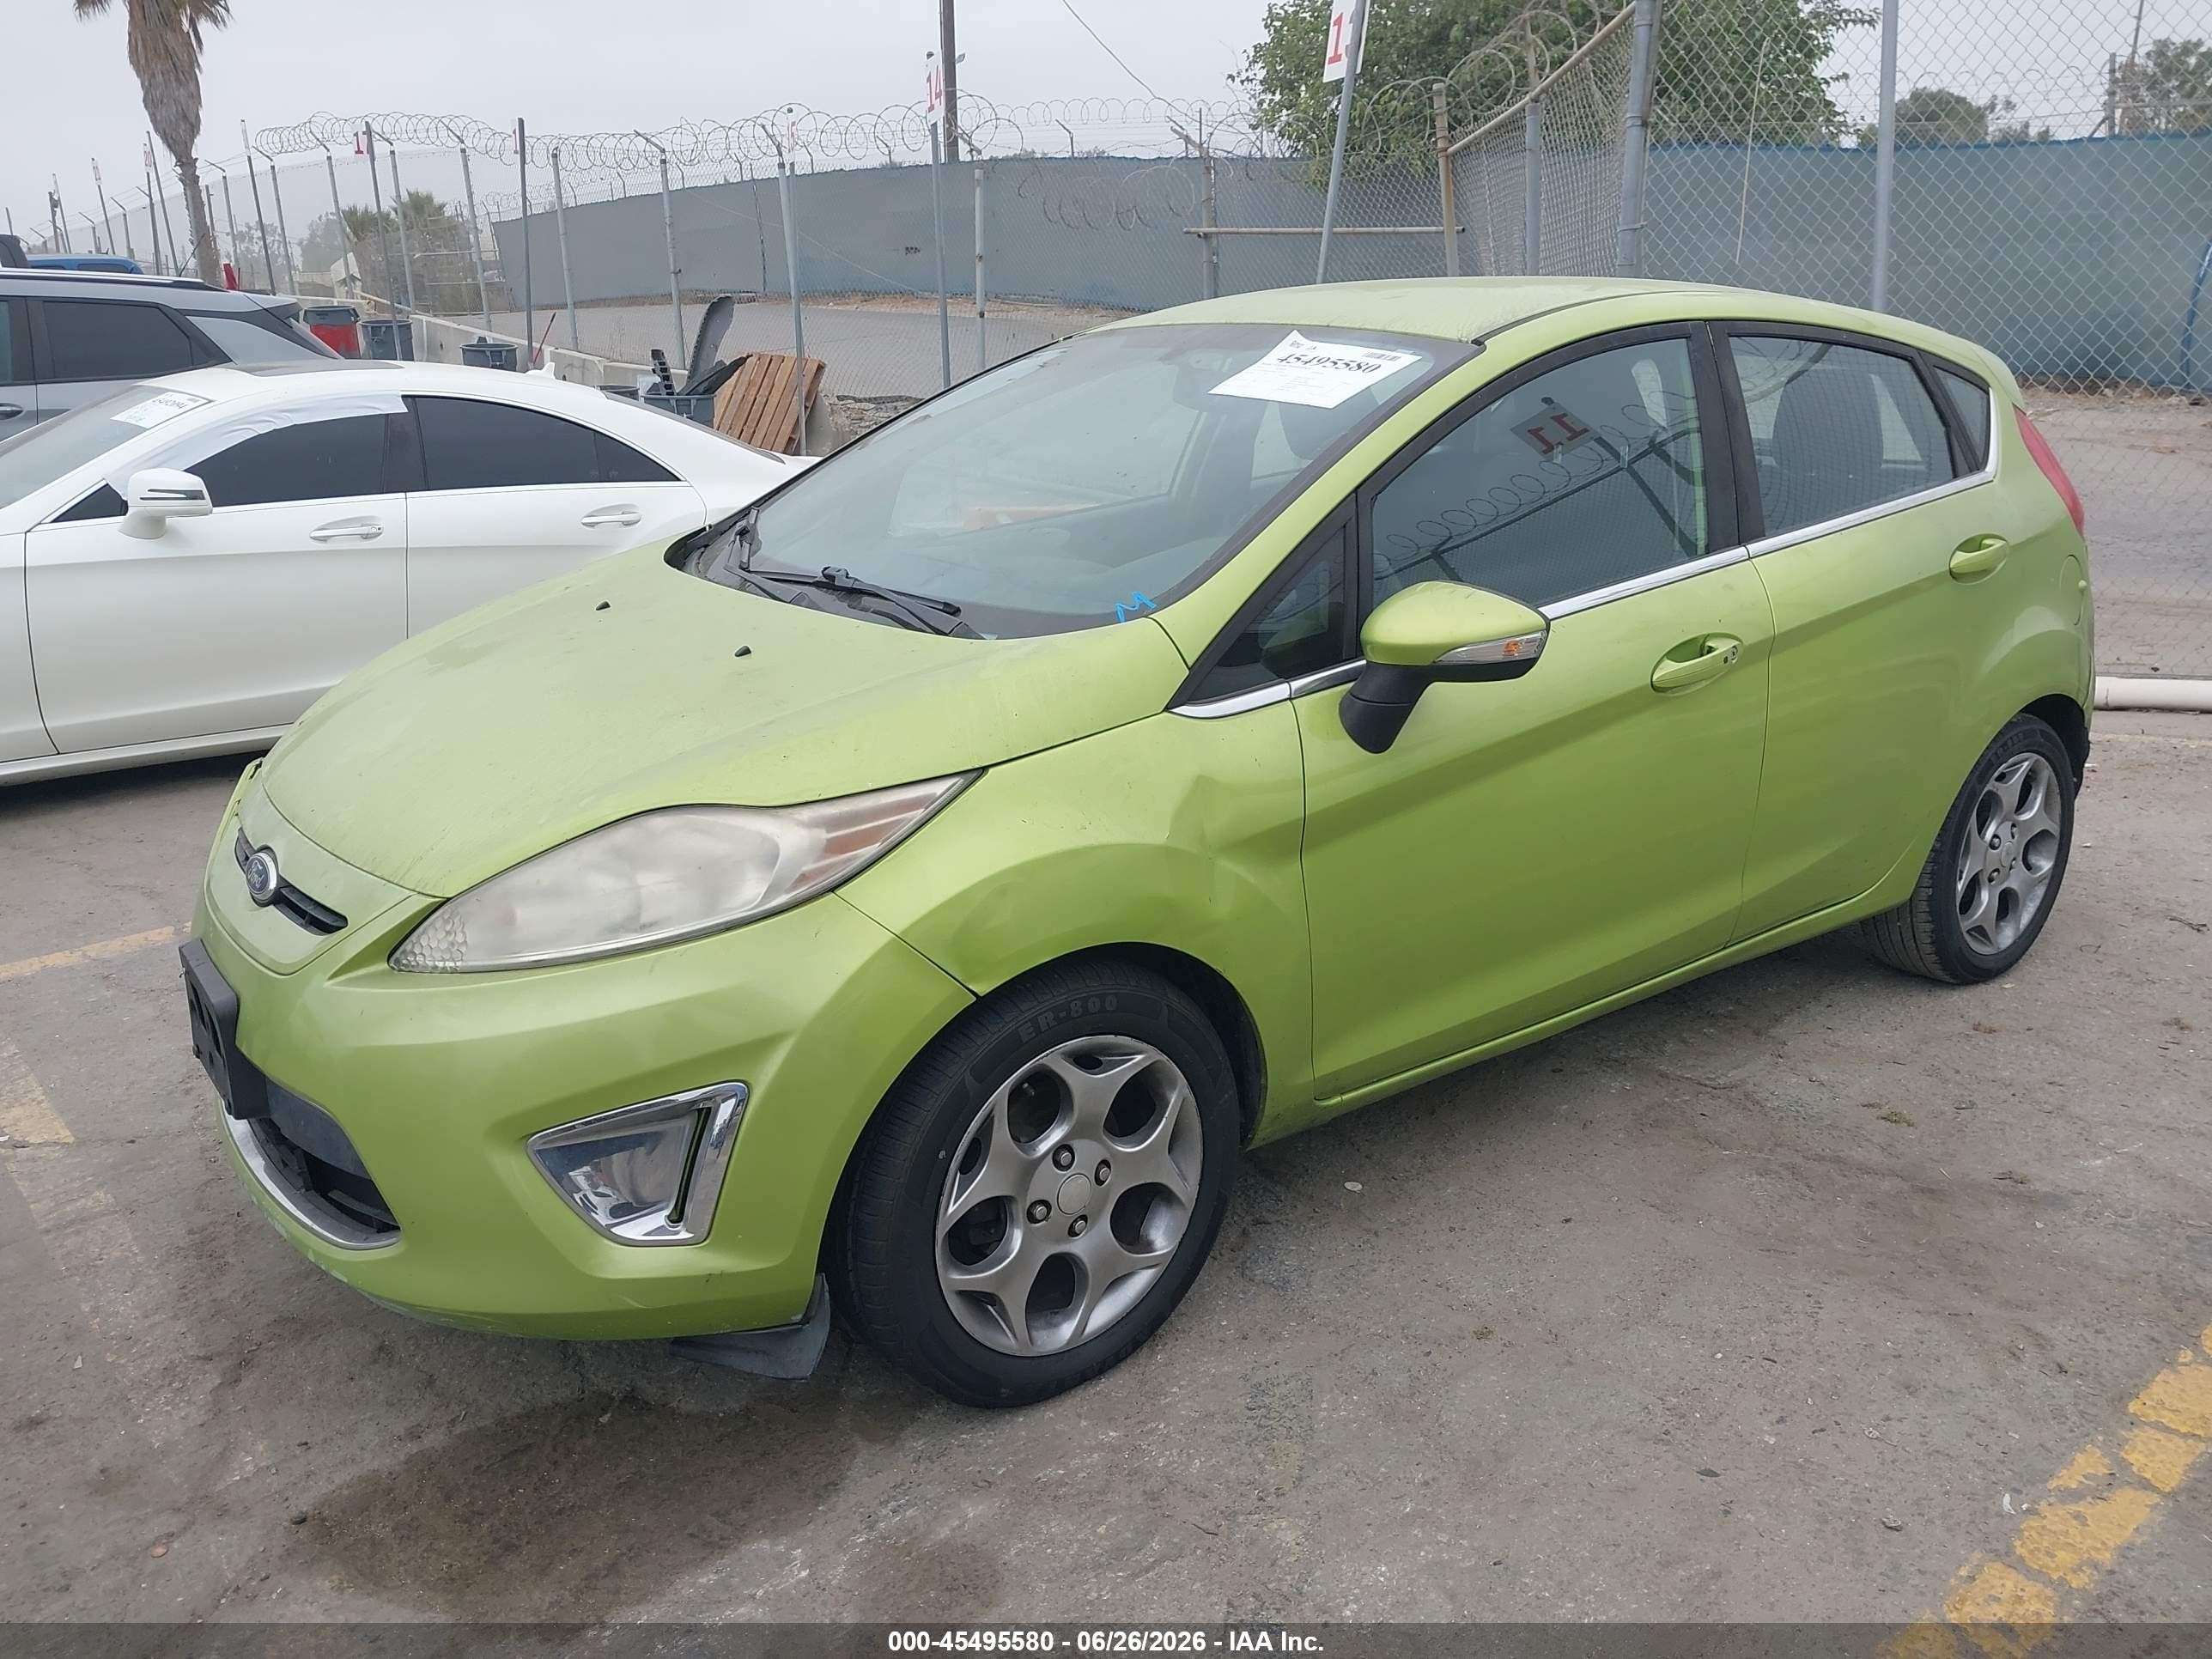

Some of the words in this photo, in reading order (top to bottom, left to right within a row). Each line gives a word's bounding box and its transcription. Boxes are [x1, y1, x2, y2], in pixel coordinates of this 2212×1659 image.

[926, 64, 943, 112] 14
[1277, 353, 1382, 374] 45495580
[248, 860, 264, 889] Ford
[1018, 996, 1117, 1043] ER-800
